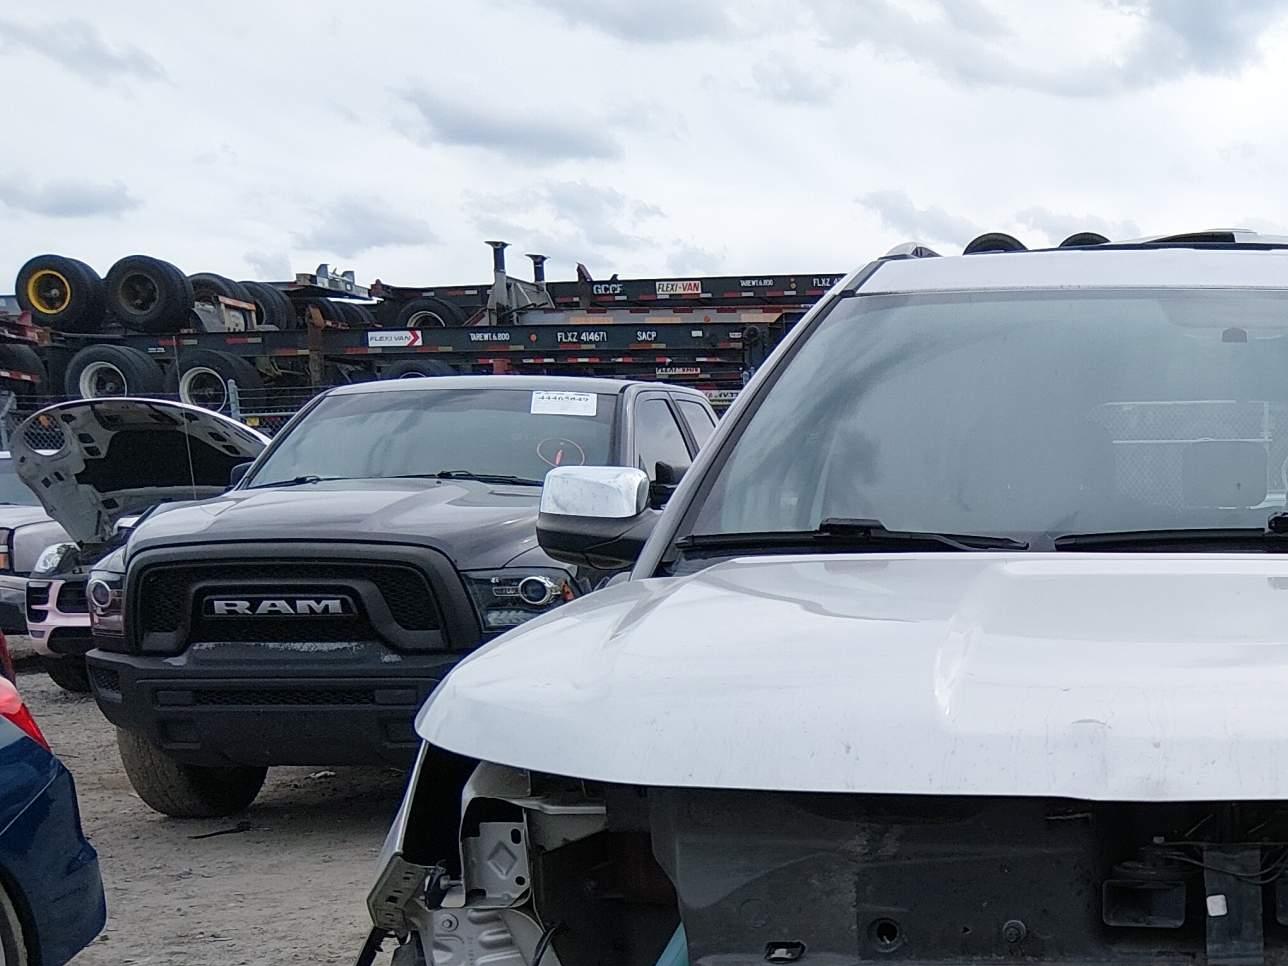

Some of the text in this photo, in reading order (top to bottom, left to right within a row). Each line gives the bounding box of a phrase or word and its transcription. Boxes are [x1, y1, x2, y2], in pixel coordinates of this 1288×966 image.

[657, 282, 701, 293] FLEXI-VAN
[557, 331, 607, 342] FLXZ 414671
[637, 331, 657, 341] SACP
[213, 600, 343, 615] RAM
